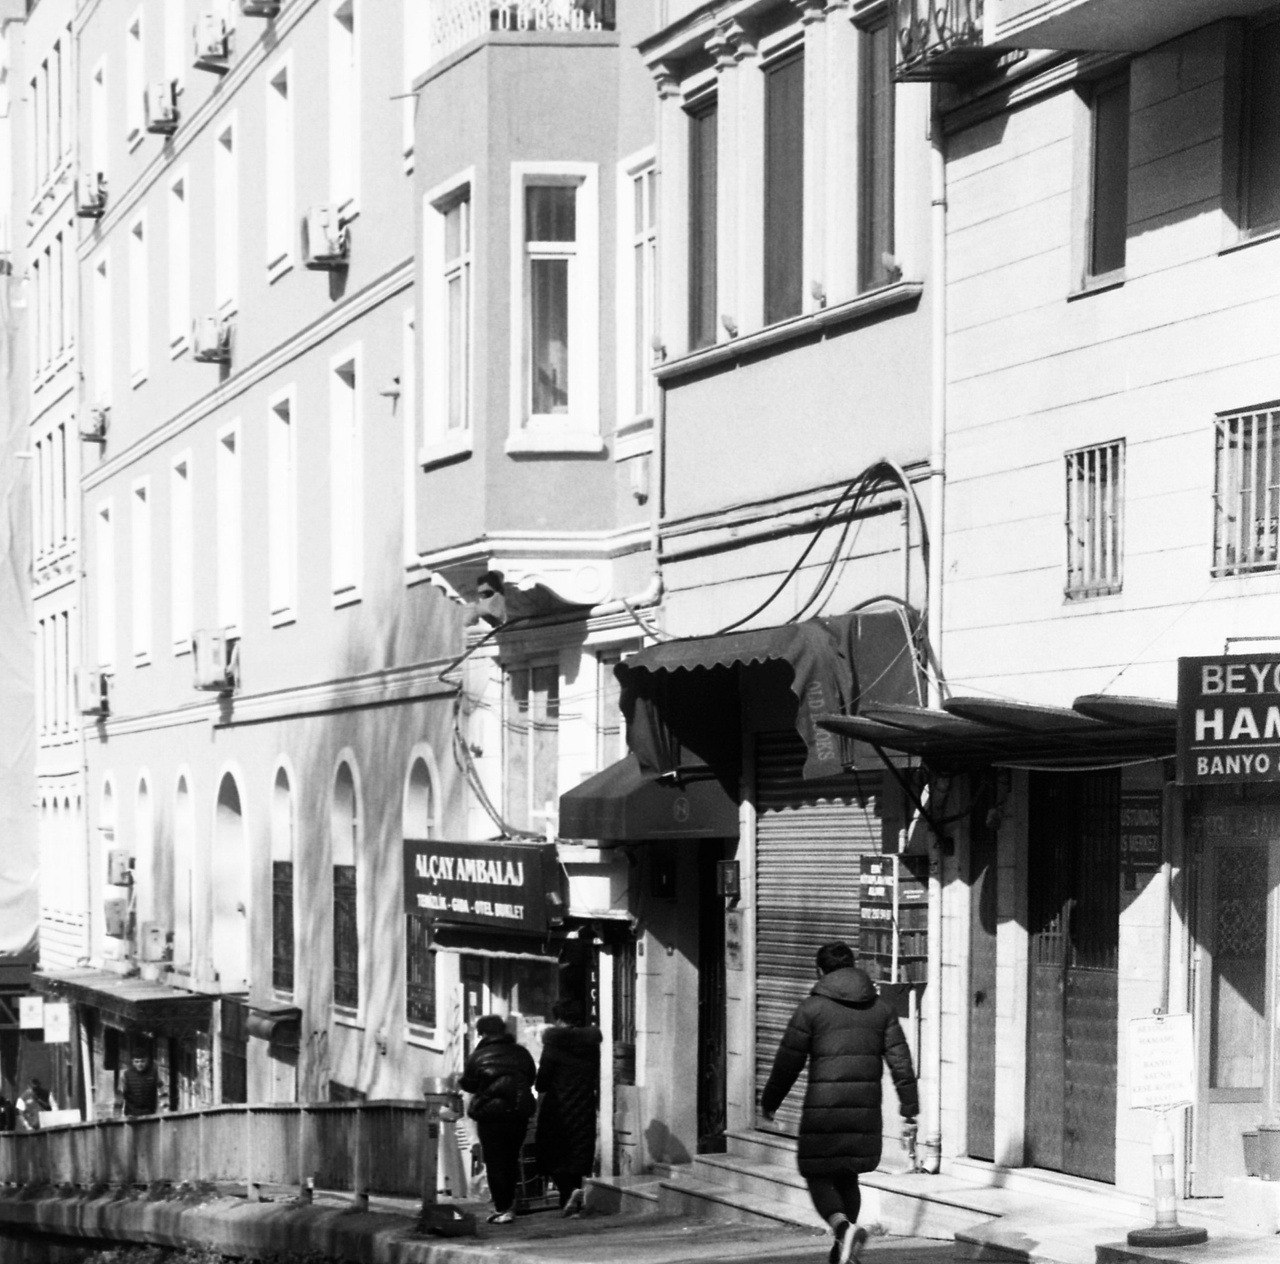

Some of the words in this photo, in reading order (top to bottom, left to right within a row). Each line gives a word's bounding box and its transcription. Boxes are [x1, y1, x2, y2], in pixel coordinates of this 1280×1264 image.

[1201, 663, 1280, 695] BEY
[1197, 752, 1270, 775] BANYO
[415, 854, 455, 885] ALÇAY
[456, 857, 524, 886] AMBALAJ
